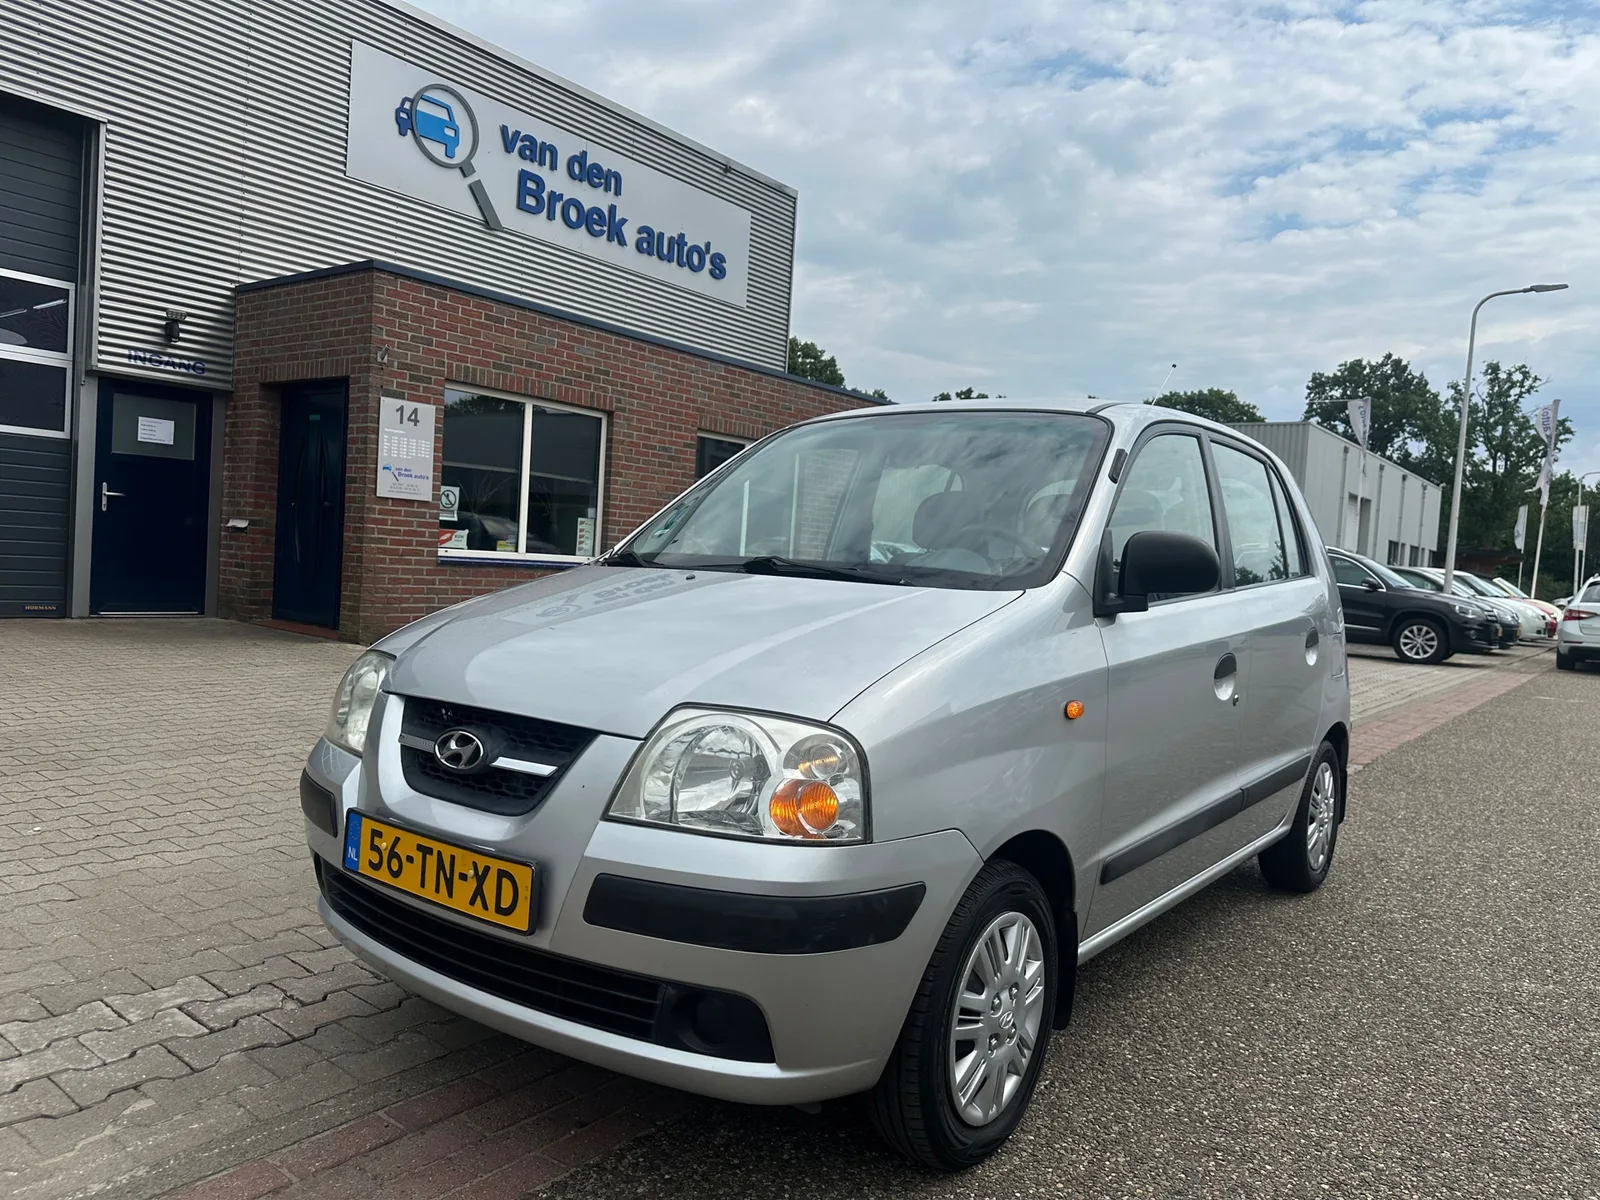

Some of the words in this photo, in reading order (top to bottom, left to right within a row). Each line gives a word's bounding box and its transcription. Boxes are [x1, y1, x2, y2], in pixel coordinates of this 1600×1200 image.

[500, 123, 558, 171] van
[567, 149, 622, 197] den
[516, 168, 629, 247] Broek
[635, 223, 727, 280] auto's
[127, 349, 206, 375] INGANG
[395, 404, 420, 427] 14
[397, 471, 413, 479] Broek
[348, 846, 358, 862] NL
[368, 828, 519, 917] 56-TN-XD
